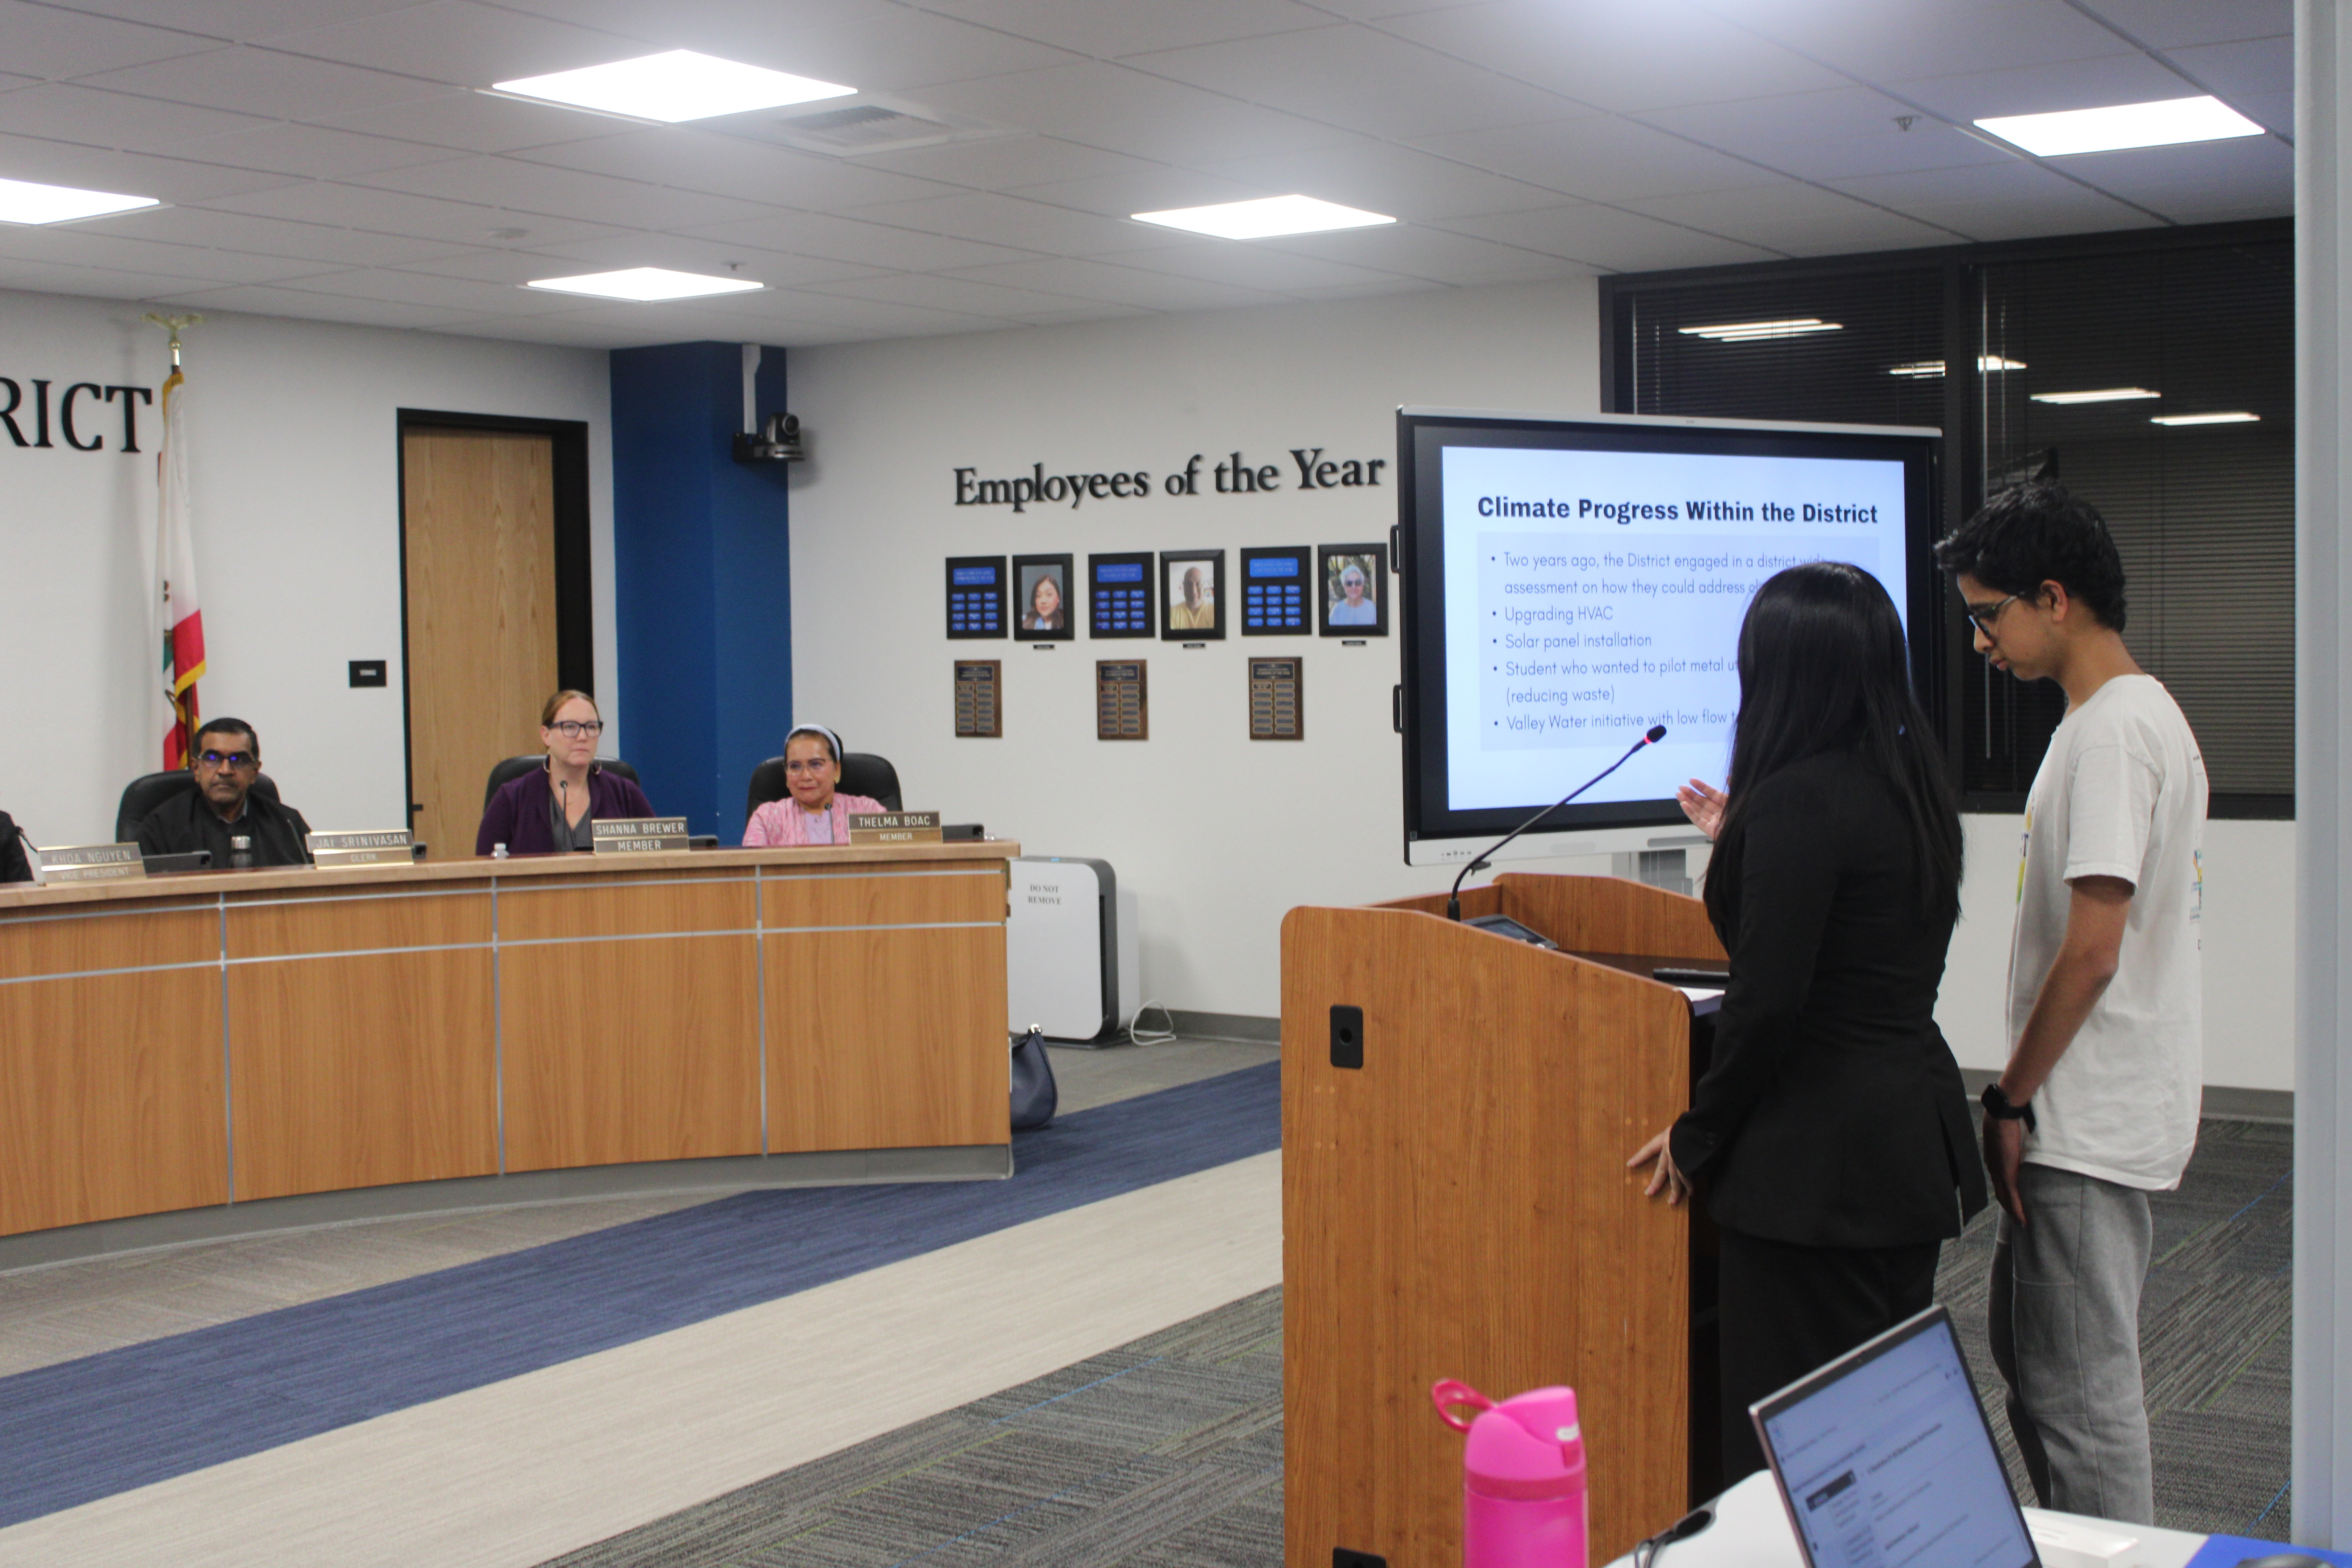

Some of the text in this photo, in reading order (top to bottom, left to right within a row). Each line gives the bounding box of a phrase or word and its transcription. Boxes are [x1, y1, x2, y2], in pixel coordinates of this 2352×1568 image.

[953, 448, 1386, 512] Employees of the Year
[1478, 496, 1878, 524] Climate Progress Within the District
[1504, 552, 1528, 567] Two
[1534, 556, 1567, 571] years
[1571, 555, 1600, 571] ago,
[1603, 552, 1624, 567] the
[1628, 553, 1671, 567] District
[1675, 553, 1728, 572] engaged
[1732, 555, 1742, 567] in
[1746, 558, 1753, 568] a
[1757, 553, 1796, 568] district
[1505, 581, 1578, 594] assessment
[1583, 583, 1598, 594] on
[1602, 578, 1628, 594] how
[1632, 578, 1658, 598] they
[1662, 579, 1694, 593] could
[1699, 578, 1745, 593] address
[1505, 605, 1613, 626] Upgrading HVAC
[1506, 631, 1652, 652] Solar panel installation
[1506, 660, 1557, 676] Student
[1562, 659, 1588, 675] who
[1592, 658, 1639, 674] wanted
[1643, 660, 1655, 673] to
[1660, 657, 1686, 677] pilot
[1691, 656, 1724, 672] metal
[1506, 684, 1614, 707] (reducing waste)
[1506, 714, 1545, 734] Valley
[1549, 714, 1587, 729] Water
[1591, 712, 1644, 728] initiative
[1648, 710, 1673, 726] with
[1677, 709, 1698, 724] low
[1702, 708, 1727, 724] flow
[596, 822, 684, 835] SHANNA BREWER
[858, 816, 930, 828] THELMA BOAC
[317, 834, 407, 848] JAI SRINIVASAN
[618, 840, 661, 851] MEMBER
[880, 832, 913, 842] MEMBER
[51, 850, 131, 865] KHOA NGUYEN
[350, 853, 378, 862] CLERK
[82, 866, 129, 878] PRESIDENT
[1028, 896, 1062, 905] REMOVE
